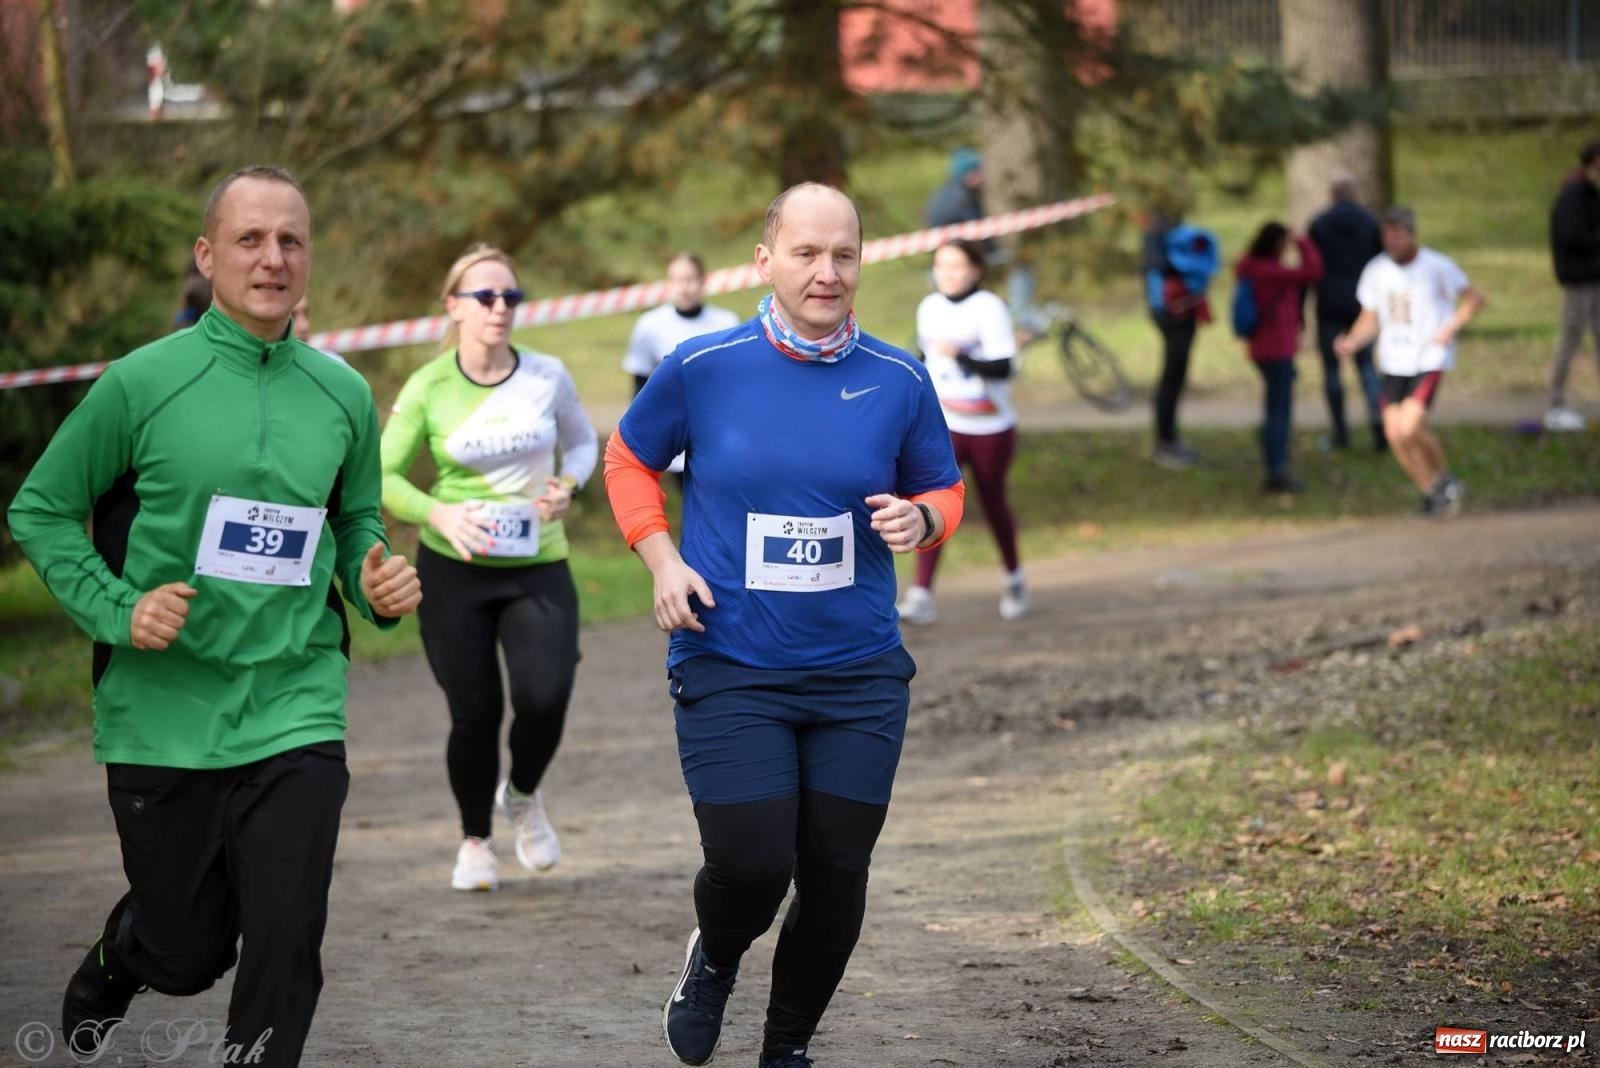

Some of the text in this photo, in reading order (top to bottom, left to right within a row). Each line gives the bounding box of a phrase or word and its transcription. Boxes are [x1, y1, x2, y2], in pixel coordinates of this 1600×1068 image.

[262, 513, 295, 525] WILCZYM
[797, 527, 828, 535] WILCZYM
[245, 526, 284, 555] 39
[786, 540, 822, 564] 40
